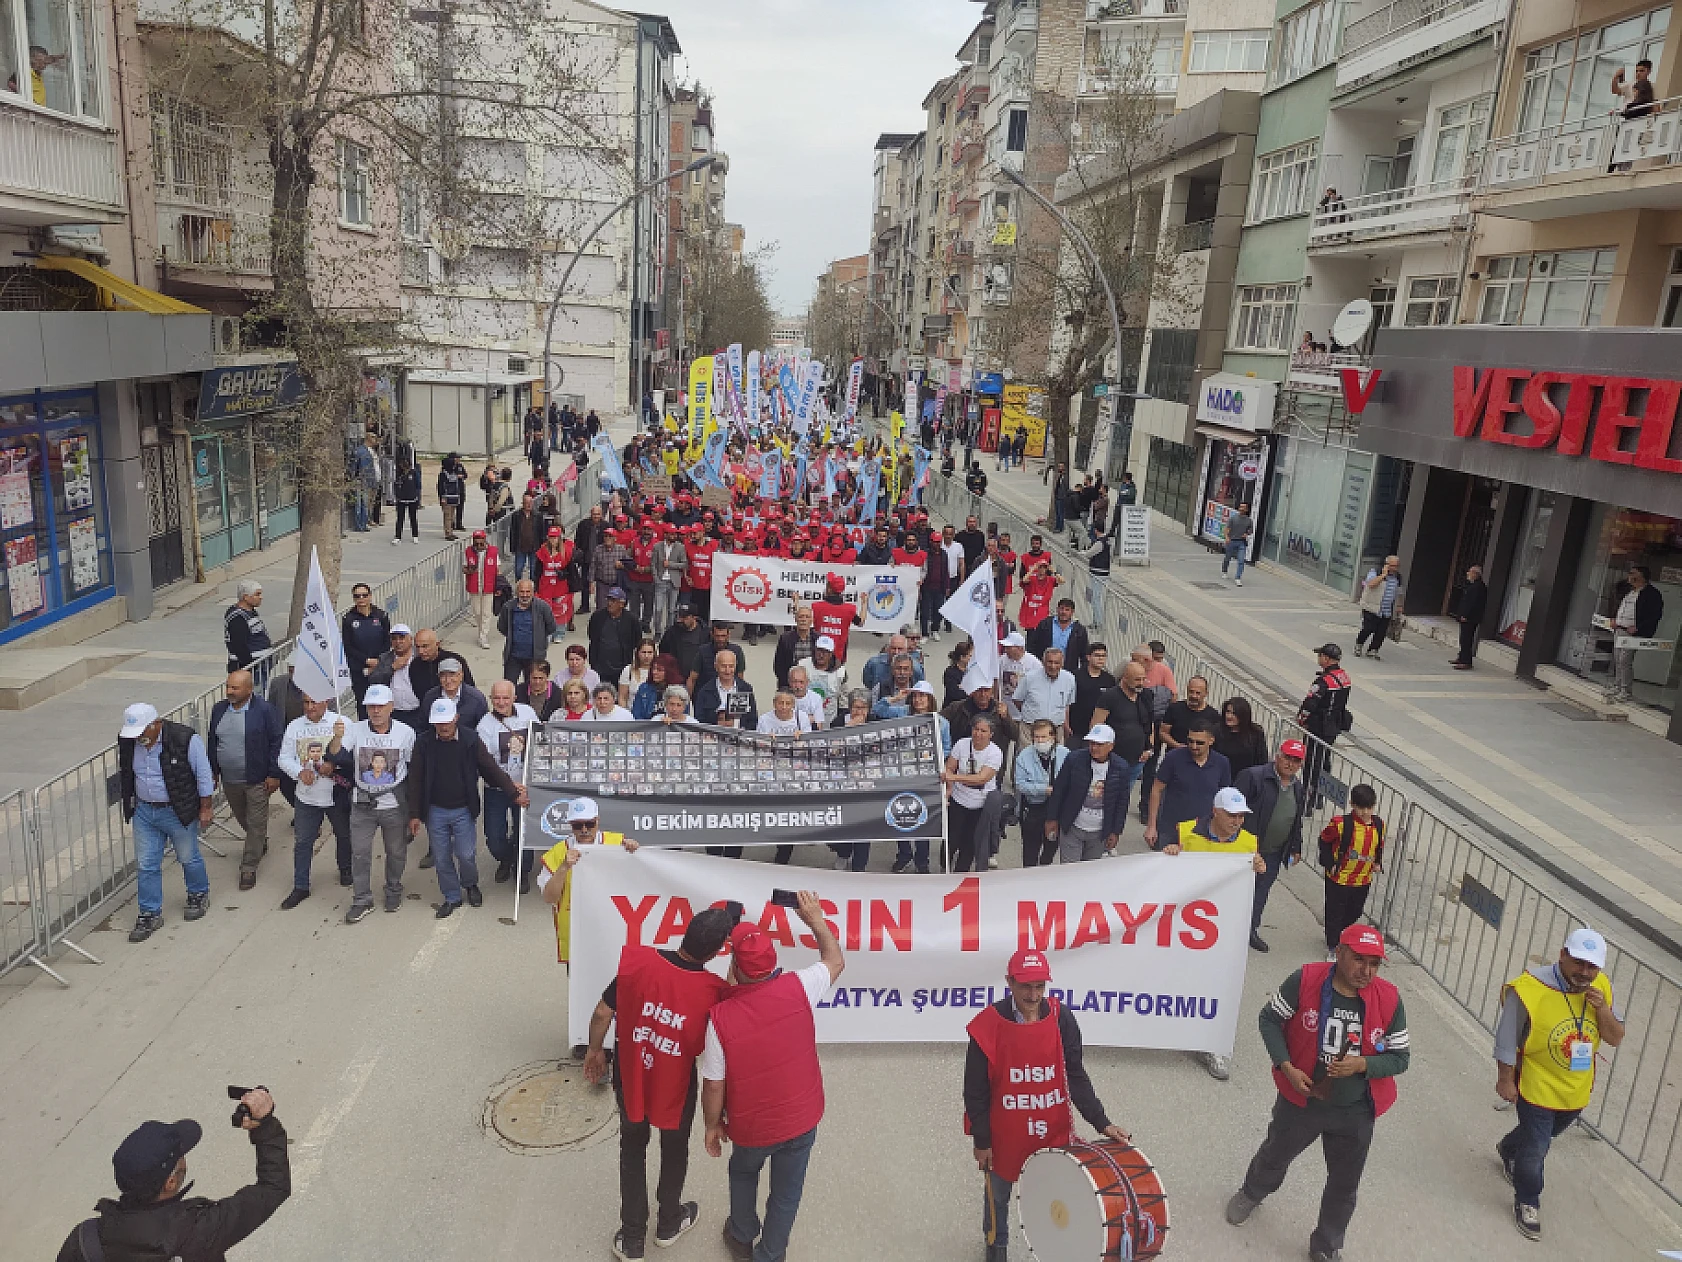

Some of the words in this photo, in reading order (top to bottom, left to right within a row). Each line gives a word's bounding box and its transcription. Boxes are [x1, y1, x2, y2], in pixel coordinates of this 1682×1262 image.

[1206, 386, 1244, 414] HADO
[1341, 369, 1382, 414] V
[1453, 365, 1682, 474] VESTEL
[781, 570, 857, 586] HEKİMN
[632, 813, 654, 831] 10
[656, 809, 704, 831] EKİM
[706, 812, 760, 833] BARIŞ
[764, 805, 843, 828] DERNEĞİ
[610, 895, 913, 956] YAASIN
[943, 877, 980, 951] 1
[1017, 899, 1219, 951] MAYIS
[912, 986, 1013, 1014] ŞUBEL
[641, 1001, 687, 1031] DİSK
[632, 1025, 682, 1057] GENEL
[1010, 1063, 1055, 1083] DİSK
[1002, 1088, 1065, 1110] GENEL
[1028, 1117, 1048, 1139] İŞ
